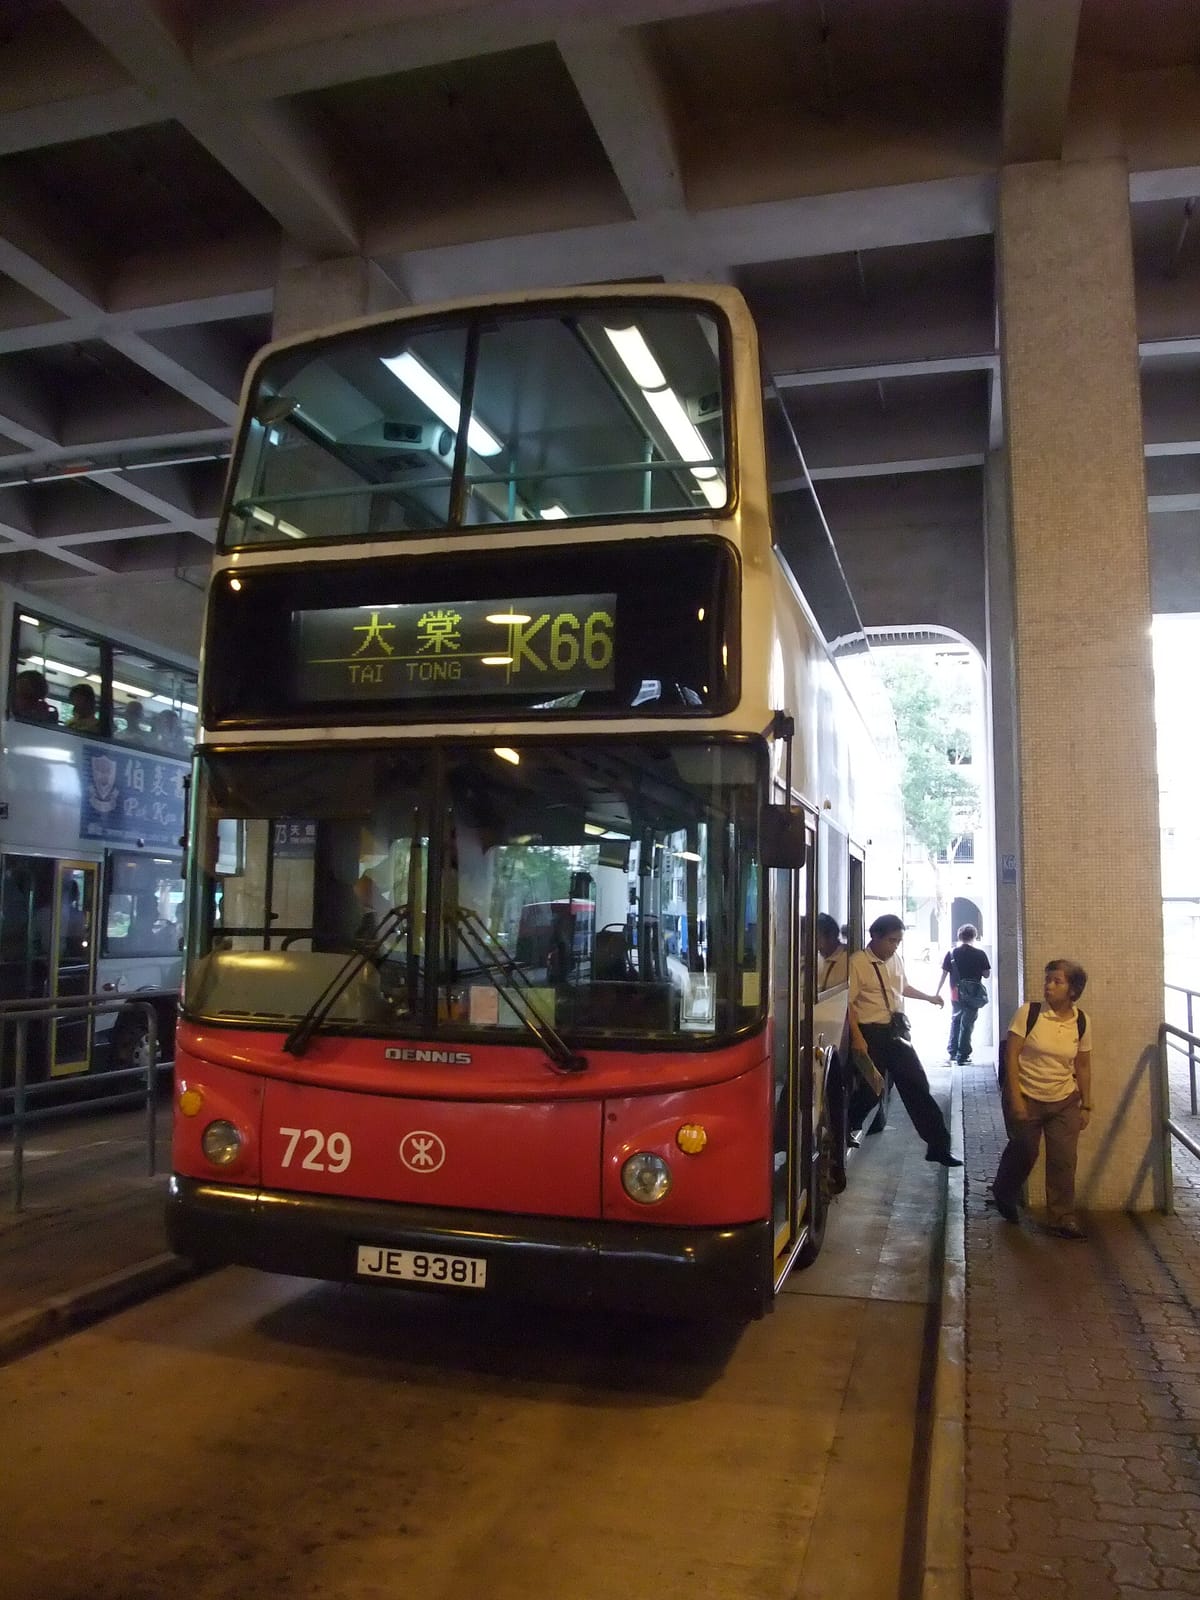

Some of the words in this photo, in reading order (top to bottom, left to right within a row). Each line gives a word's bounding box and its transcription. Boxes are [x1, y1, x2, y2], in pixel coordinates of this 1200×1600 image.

[352, 609, 462, 656] 大棠
[513, 611, 613, 673] K66
[349, 664, 384, 683] TAI
[406, 660, 462, 681] TONG
[385, 1047, 472, 1065] DENNIS
[279, 1127, 352, 1173] 729
[367, 1251, 403, 1275] JE
[412, 1255, 478, 1284] 9381
